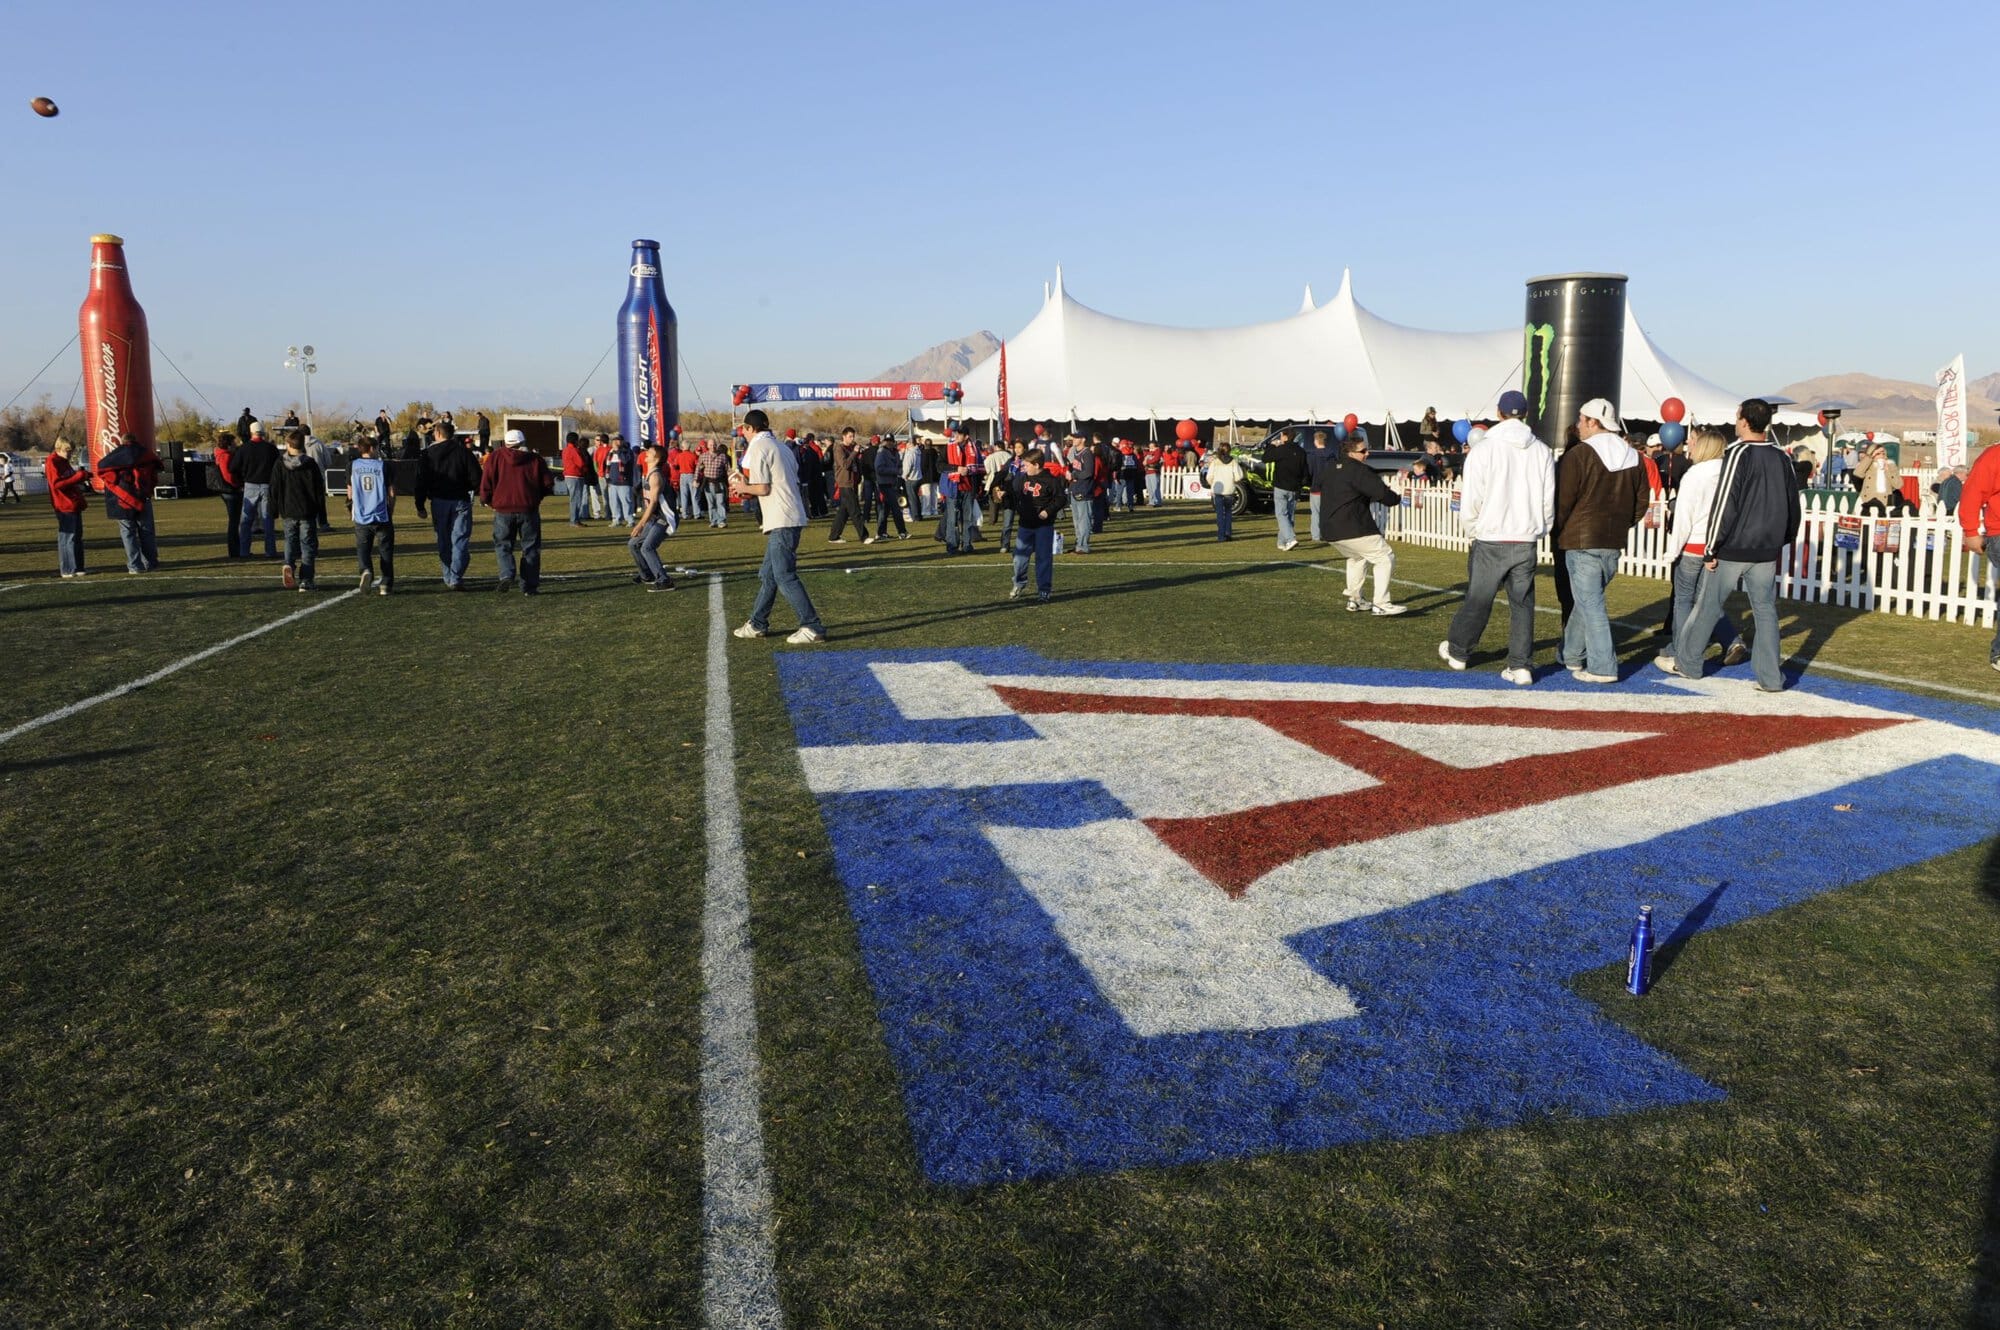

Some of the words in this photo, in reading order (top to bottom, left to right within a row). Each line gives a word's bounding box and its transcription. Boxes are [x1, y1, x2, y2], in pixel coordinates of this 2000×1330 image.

[101, 342, 122, 457] Budweiser
[639, 353, 649, 412] LIGHT
[798, 386, 814, 398] VIP
[815, 386, 870, 398] HOSPITALITY
[870, 386, 892, 398] TENT
